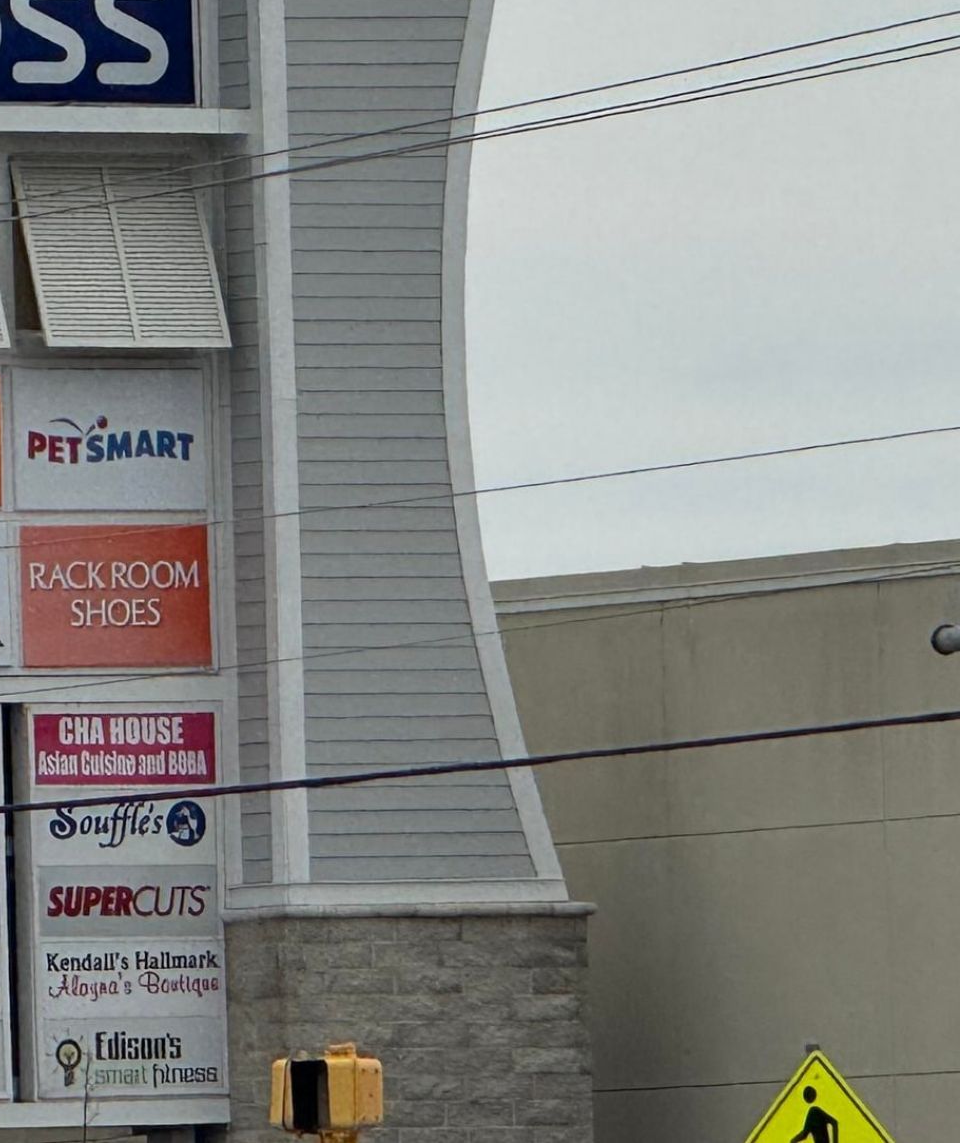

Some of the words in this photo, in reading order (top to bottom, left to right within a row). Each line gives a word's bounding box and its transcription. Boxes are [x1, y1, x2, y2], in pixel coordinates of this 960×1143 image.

[28, 429, 194, 464] PETSMART
[29, 561, 105, 590] RACK
[112, 560, 200, 590] ROOM
[71, 599, 160, 627] SHOES
[59, 717, 104, 745] CHA
[110, 717, 184, 745] HOUSE
[38, 751, 77, 776] Asian
[81, 750, 135, 776] Cuisine
[138, 750, 165, 776] and
[168, 750, 207, 776] BOBA
[47, 885, 206, 917] SUPERCUTS
[46, 952, 129, 972] Kendall's
[135, 950, 220, 971] Hallmark
[138, 970, 219, 997] Boutique
[95, 1031, 182, 1060] Edison's
[95, 1064, 147, 1085] smart
[152, 1063, 218, 1088] fitness
